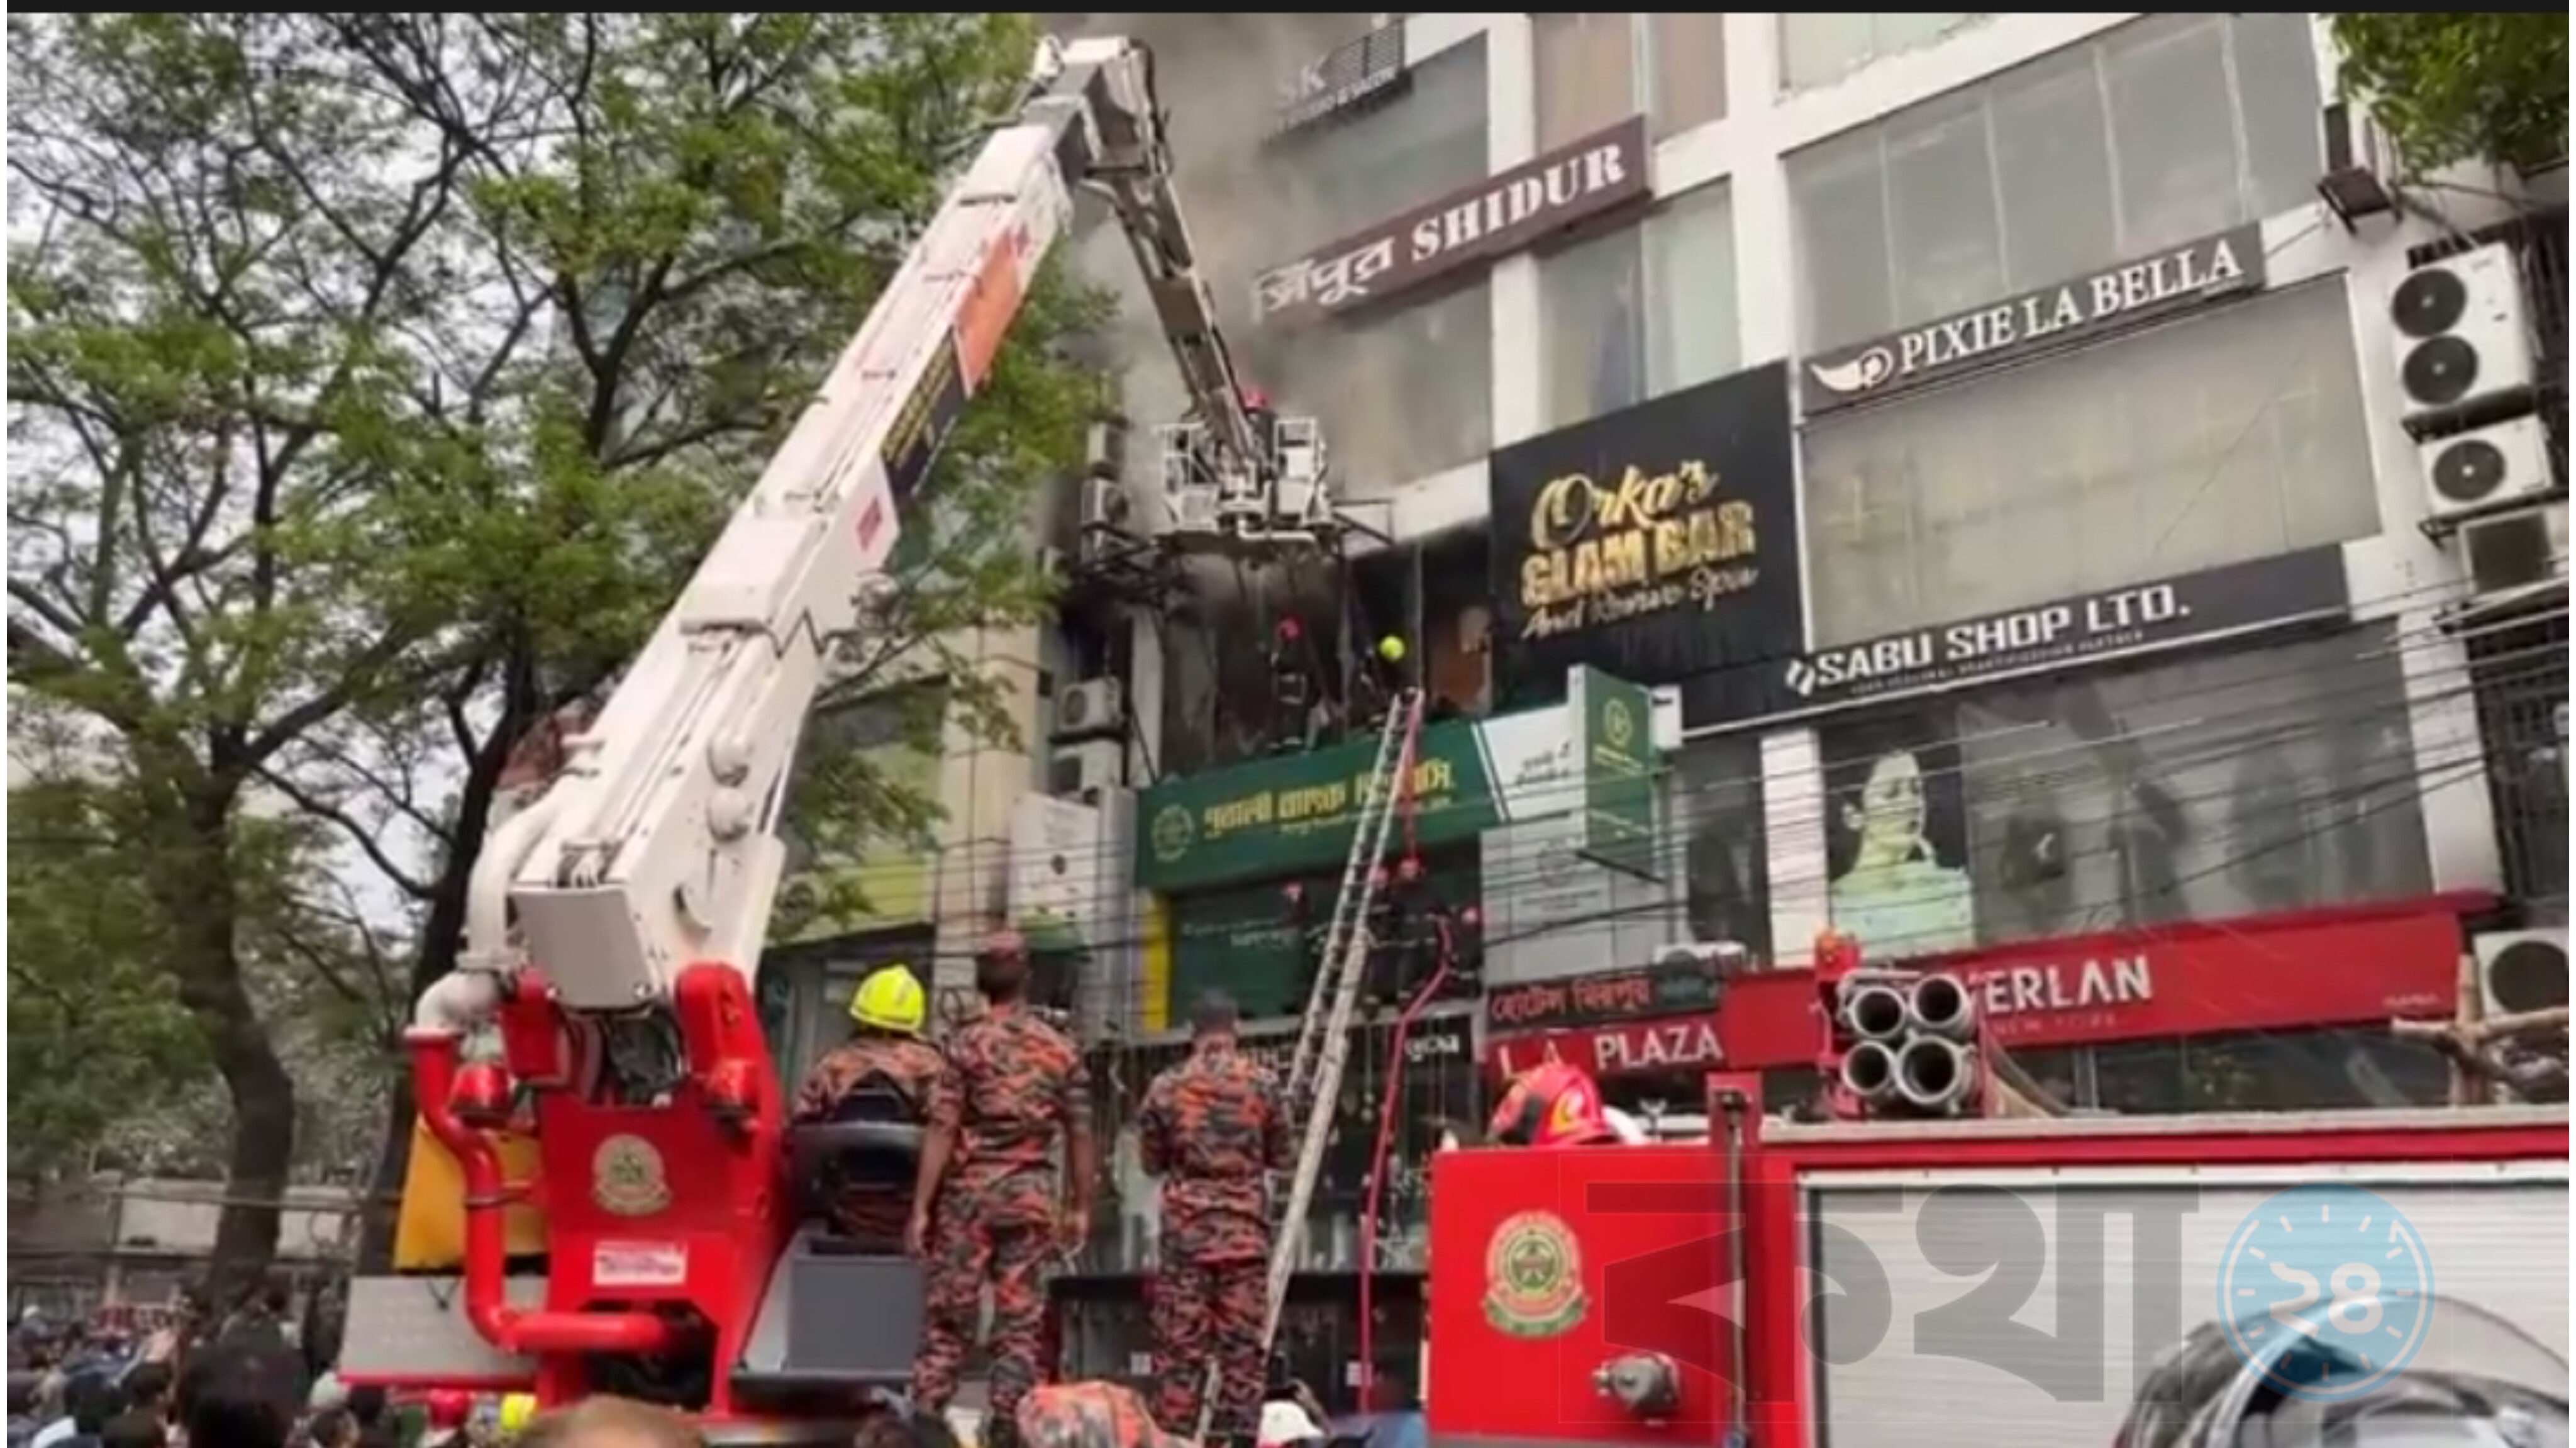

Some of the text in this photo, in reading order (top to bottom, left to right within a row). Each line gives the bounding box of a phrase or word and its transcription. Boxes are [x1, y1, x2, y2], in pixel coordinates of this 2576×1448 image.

[1410, 142, 1627, 263] SHIDUR
[1900, 239, 2243, 374] PIXIE LA BELLA
[1531, 459, 1719, 549] Orka's
[1521, 500, 1756, 606] GLAM BAR
[1521, 598, 1584, 640] And
[1817, 584, 2191, 686] SABU SHOP LTD.
[1975, 955, 2154, 1014] ERLAN
[1595, 1023, 1723, 1070] PLAZA
